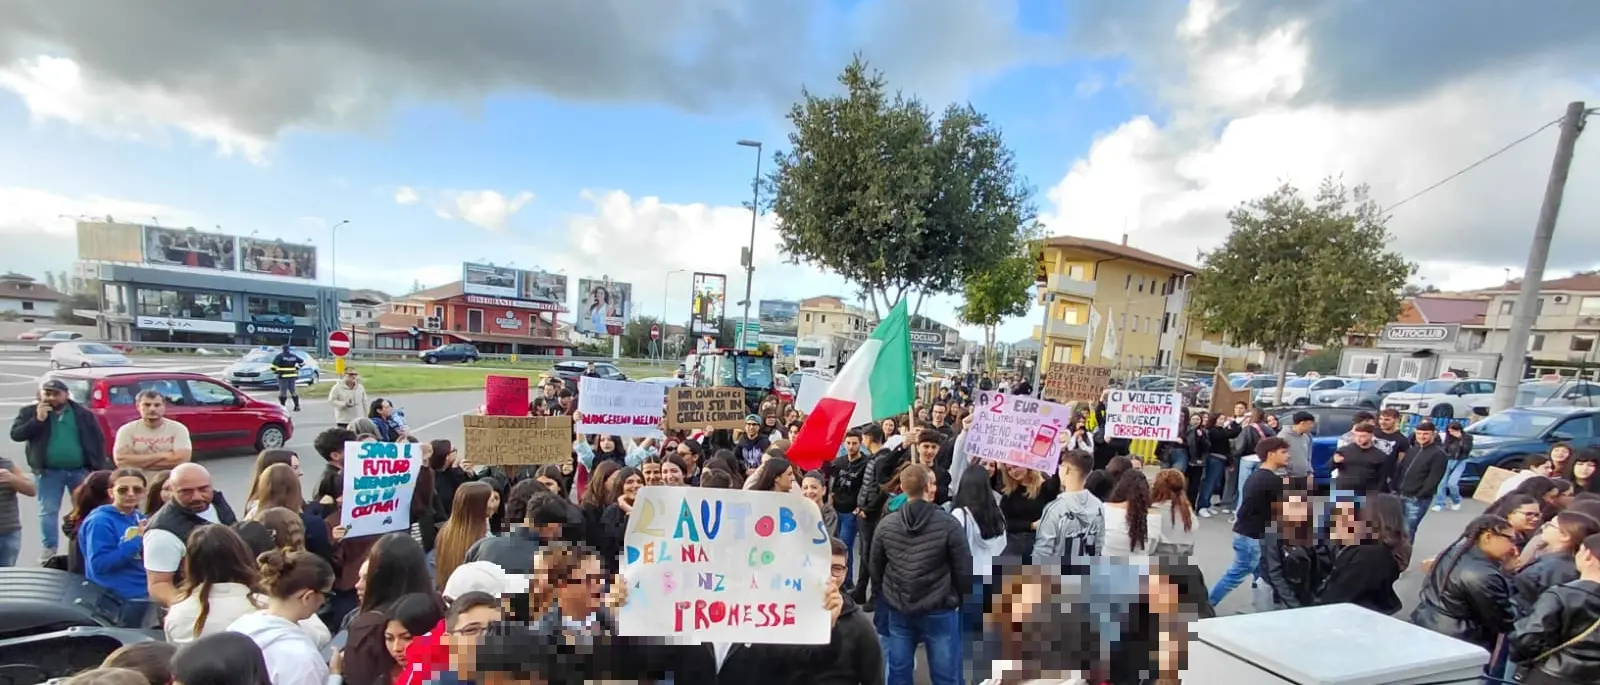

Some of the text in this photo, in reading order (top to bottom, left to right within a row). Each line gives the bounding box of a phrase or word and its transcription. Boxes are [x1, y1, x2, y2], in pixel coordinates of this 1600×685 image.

[143, 319, 192, 327] DACIA
[1391, 329, 1442, 338] AUTOCLUB
[980, 392, 989, 406] A
[989, 394, 1005, 414] 2
[1111, 392, 1122, 402] CI
[1128, 392, 1174, 405] VOLETE
[730, 399, 742, 410] IN
[1121, 403, 1174, 415] IGNORANTI
[992, 414, 1014, 424] LITRO
[1107, 413, 1122, 423] PER
[970, 423, 1012, 437] ALMENO
[1113, 424, 1171, 439] OBBEDIENTI
